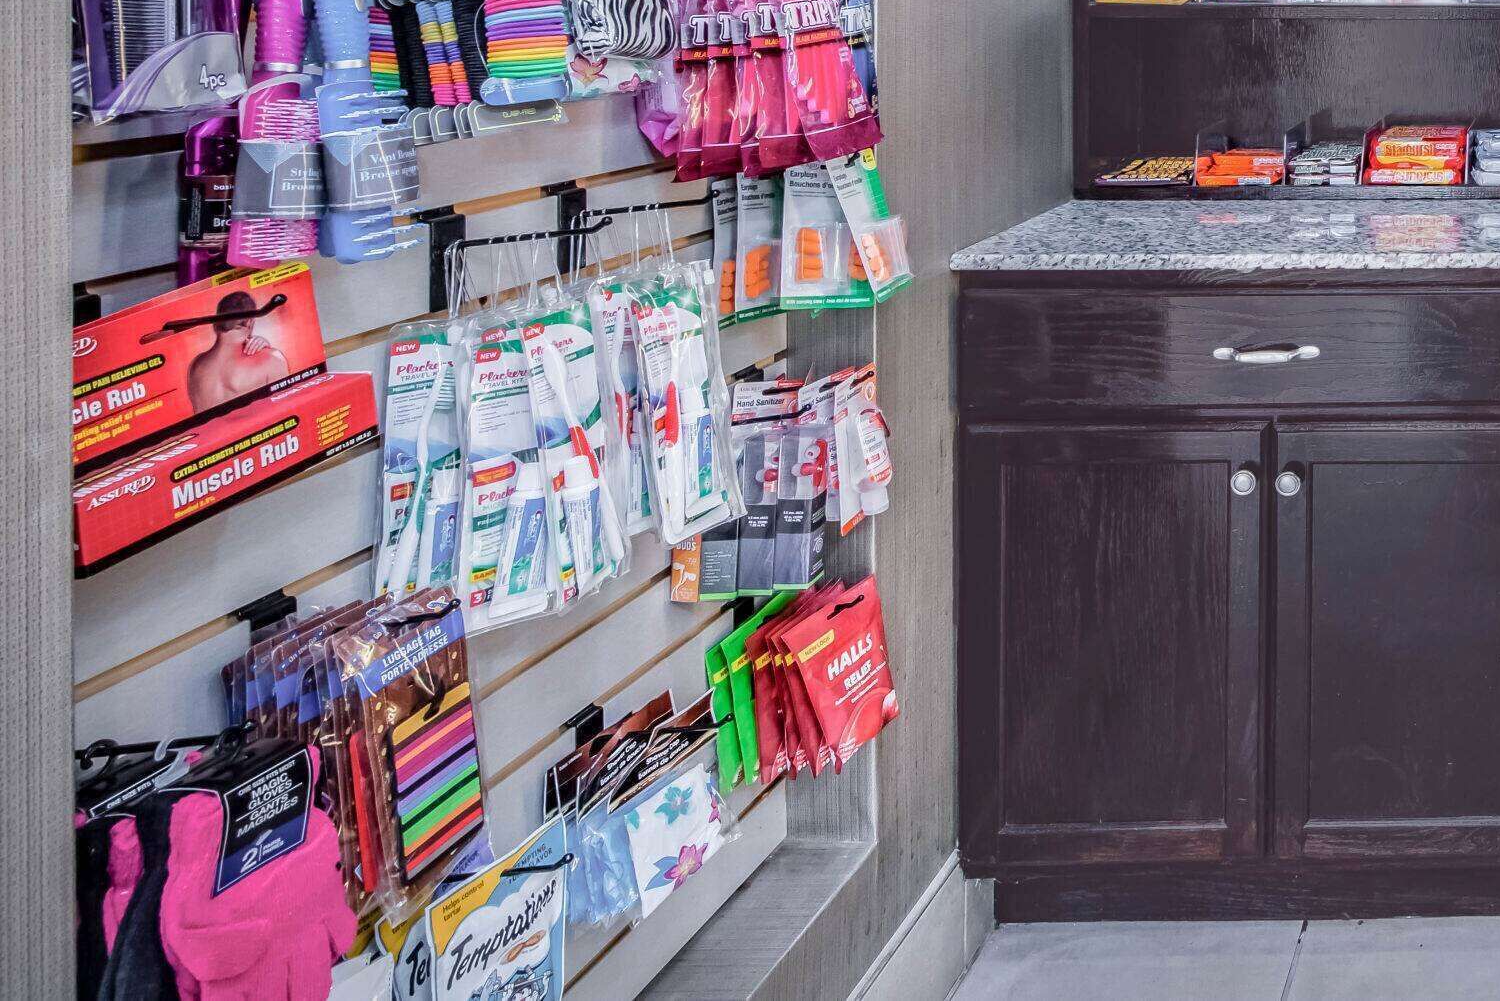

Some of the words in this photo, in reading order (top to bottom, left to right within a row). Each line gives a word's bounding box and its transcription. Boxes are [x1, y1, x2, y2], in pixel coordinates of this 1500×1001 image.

[200, 64, 226, 89] 4pc
[369, 152, 396, 165] Vent
[789, 170, 818, 181] Earplugs
[789, 180, 821, 189] Bouchons
[524, 327, 541, 337] NEW
[394, 343, 417, 353] NEW
[479, 351, 497, 360] NEW
[396, 359, 454, 377] Plackes
[399, 372, 432, 382] TRAVEL
[479, 368, 529, 384] Plackers
[106, 381, 146, 410] Rub
[736, 399, 755, 408] Hand
[756, 398, 785, 406] Sanitizer
[174, 463, 198, 480] EXTRA
[198, 447, 234, 469] STRENGTH
[234, 441, 250, 452] PAIN
[250, 428, 284, 445] RELIEVING
[284, 419, 297, 429] GEL
[171, 456, 254, 509] Muscle
[260, 434, 299, 467] Rub
[87, 475, 155, 511] ASSURED
[474, 592, 484, 604] 3
[383, 634, 424, 668] LUGGAGE
[424, 625, 442, 643] TAG
[826, 632, 873, 681] HALLS
[843, 659, 873, 691] RELIEF
[646, 747, 669, 765] Shower
[668, 738, 680, 749] Cap
[669, 740, 690, 759] douche
[238, 786, 250, 797] ONE
[266, 770, 279, 782] FITS
[279, 760, 296, 774] MOST
[251, 772, 288, 800] MAGIC
[248, 779, 292, 811] GLOVES
[250, 793, 289, 822] GANTS
[237, 796, 299, 839] MAGIQUES
[240, 850, 258, 875] 2
[442, 895, 462, 913] Helps
[461, 880, 485, 901] control
[443, 905, 462, 922] tartar
[446, 879, 557, 991] Temptations
